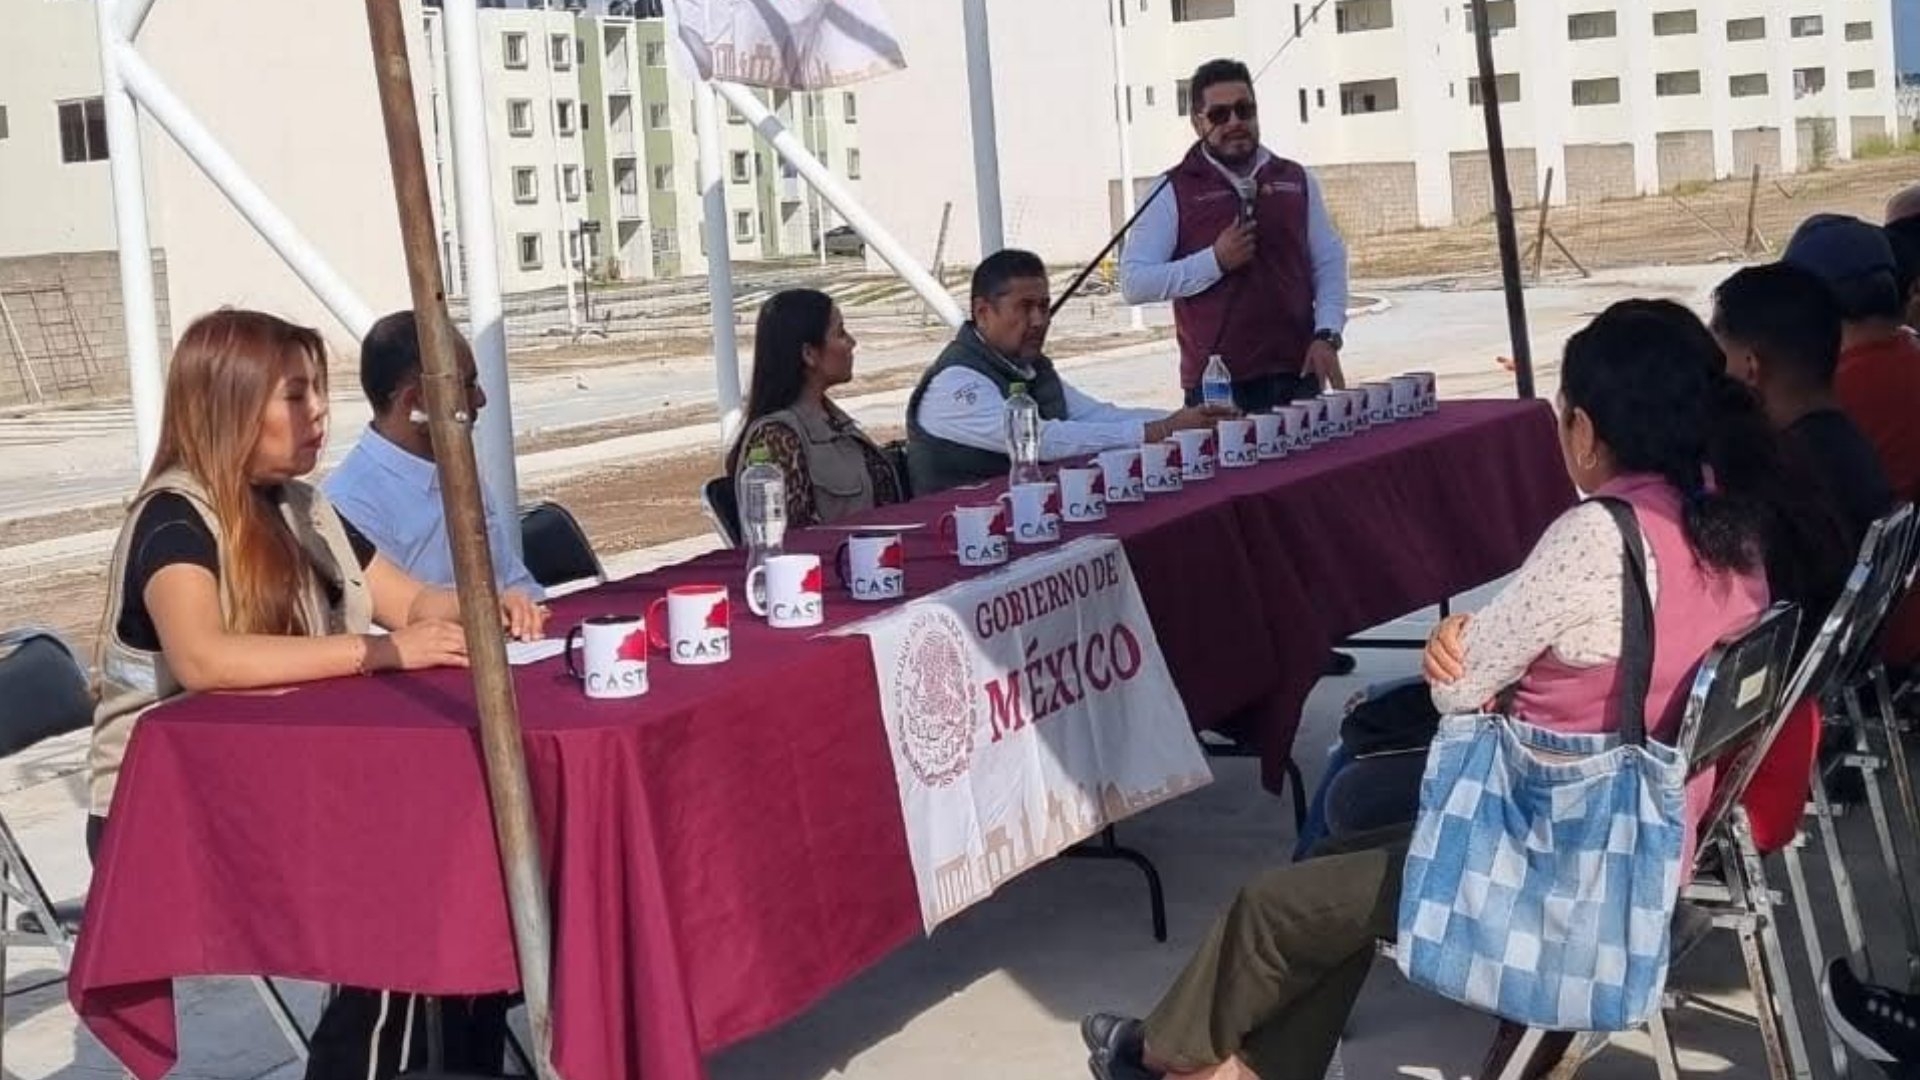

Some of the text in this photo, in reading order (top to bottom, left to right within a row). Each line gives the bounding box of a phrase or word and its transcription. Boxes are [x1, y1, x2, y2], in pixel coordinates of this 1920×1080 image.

[976, 553, 1119, 639] GOBIERNO DE
[676, 636, 728, 658] CAST
[587, 669, 643, 692] CAST
[985, 623, 1141, 743] MÉXICO
